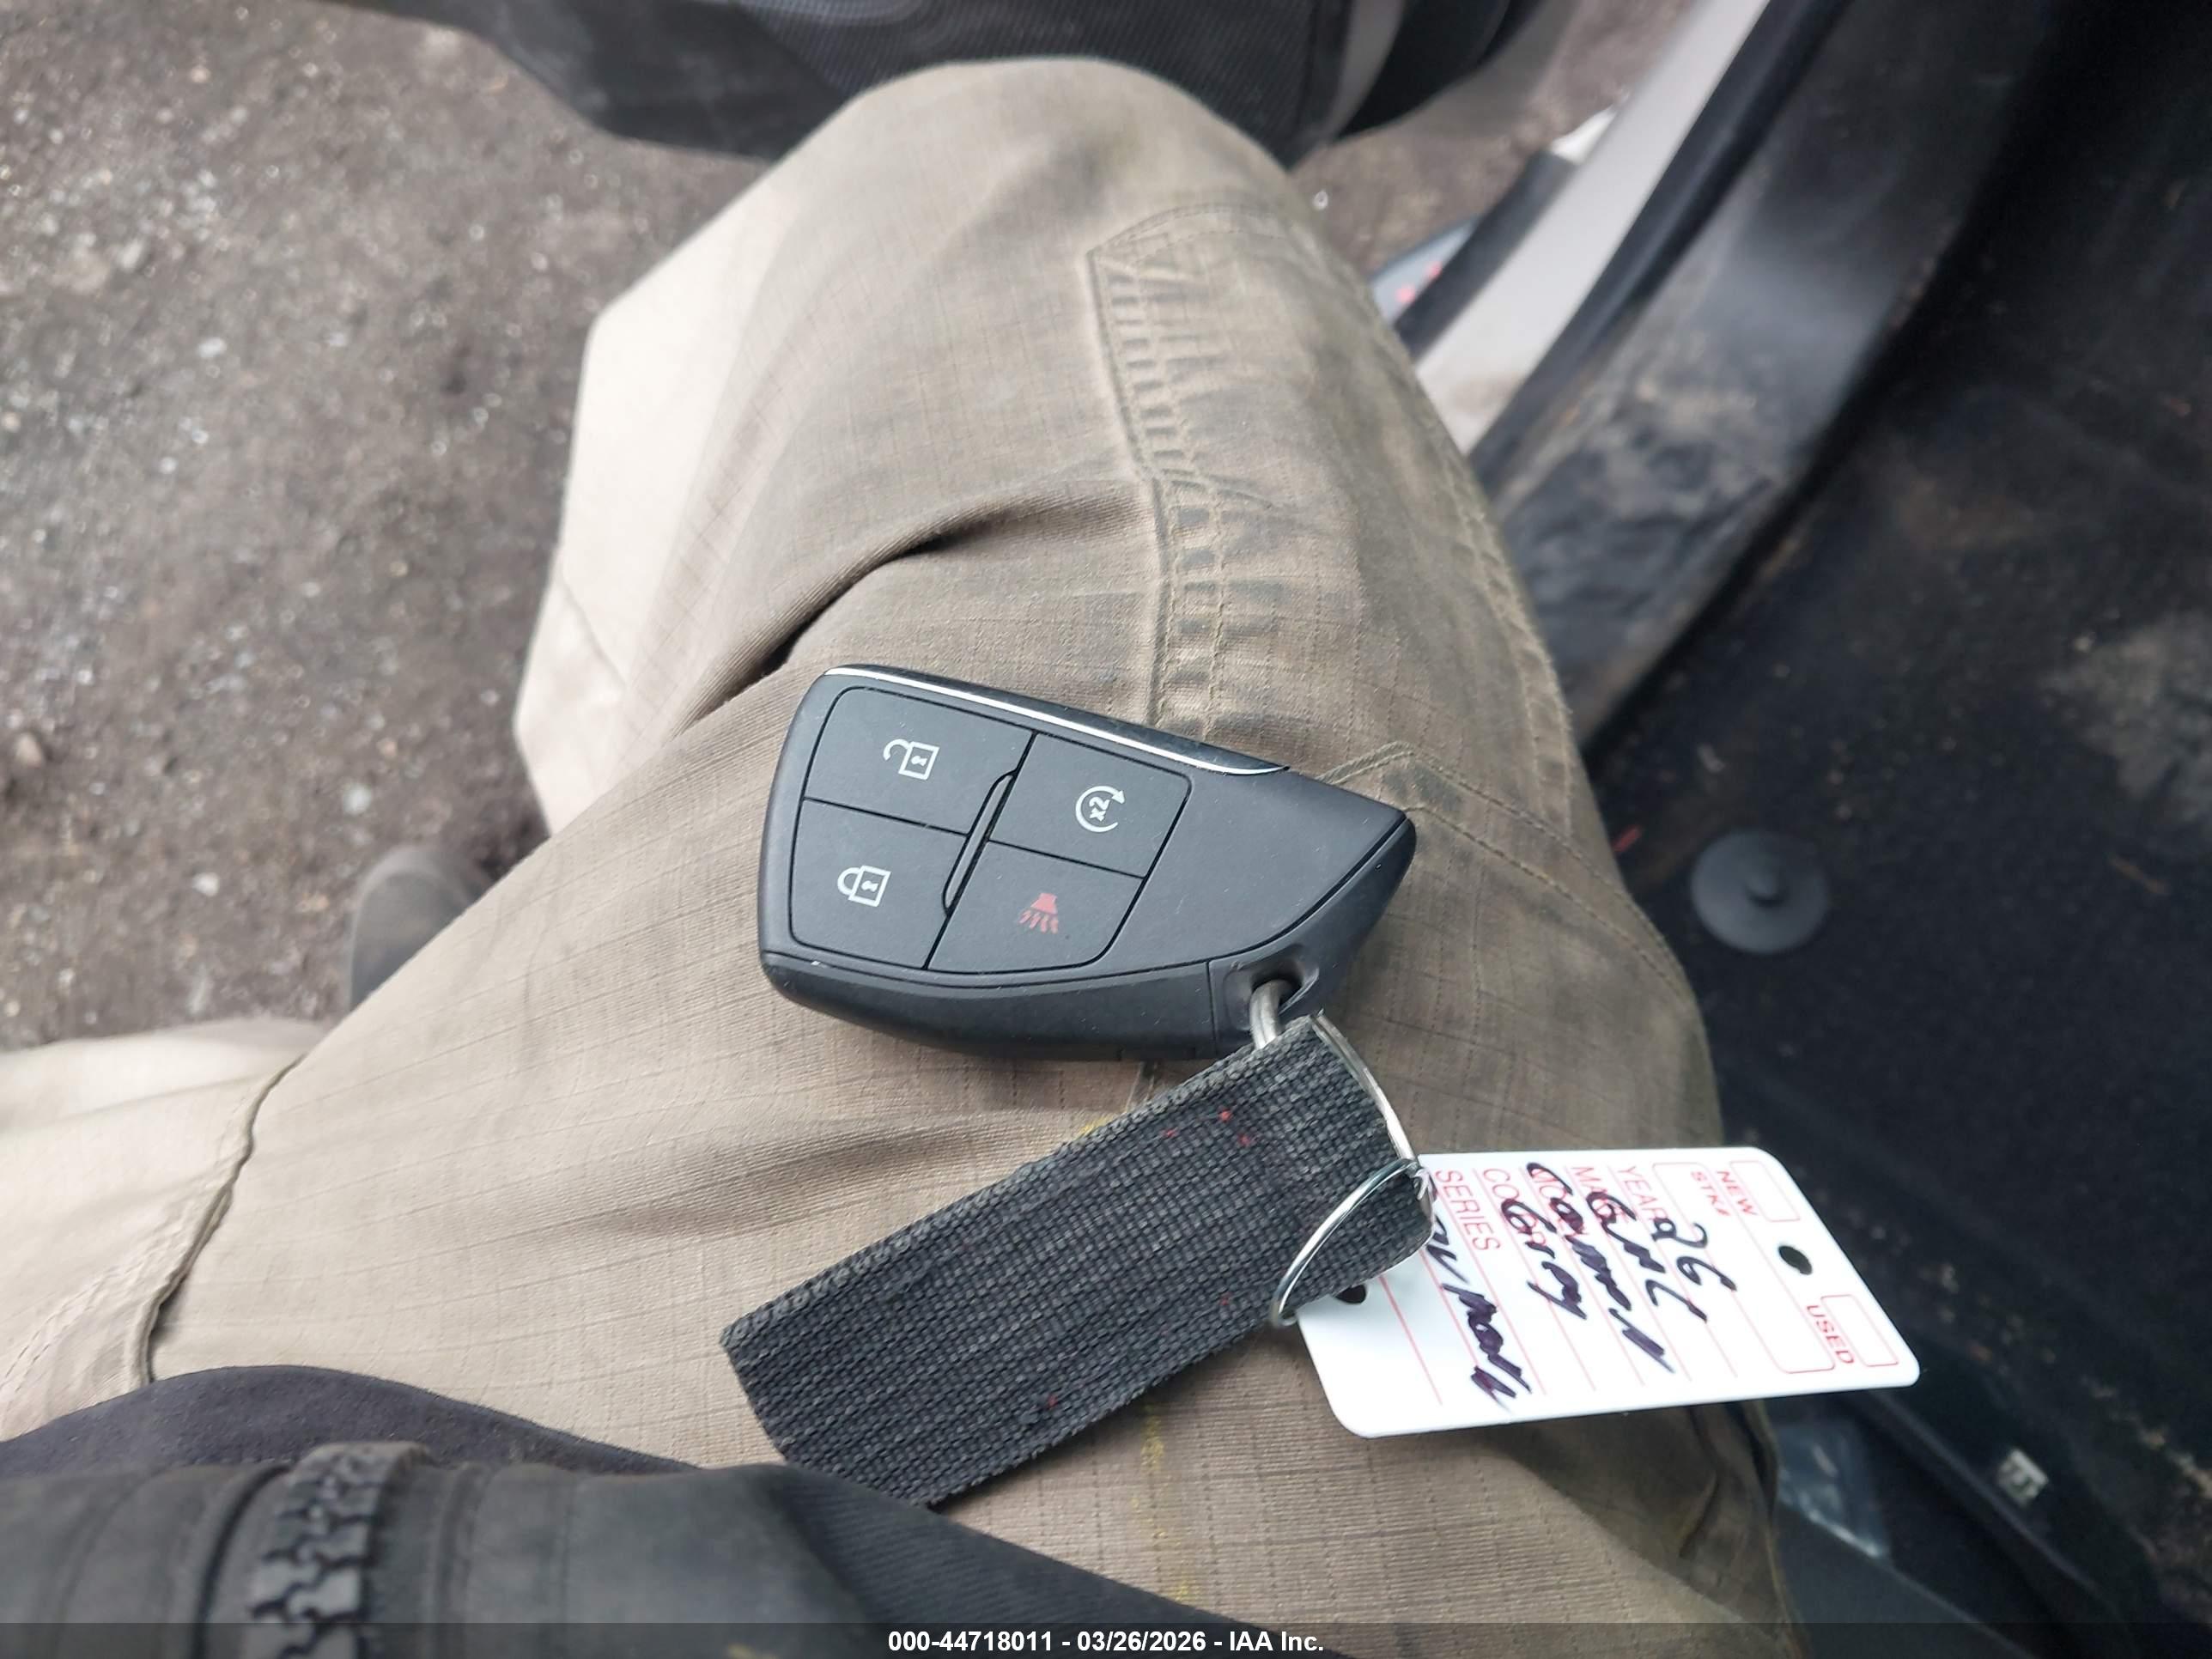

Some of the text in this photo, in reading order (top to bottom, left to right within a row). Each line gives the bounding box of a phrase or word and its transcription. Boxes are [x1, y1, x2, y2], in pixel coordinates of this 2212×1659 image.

[1435, 1170, 1500, 1251] SERIES
[1483, 1168, 1547, 1246] COOR
[1617, 1165, 1669, 1221] YEAR
[1717, 1170, 1759, 1216] NEW
[1650, 1221, 1737, 1291] 26
[1806, 1304, 1855, 1364] USED
